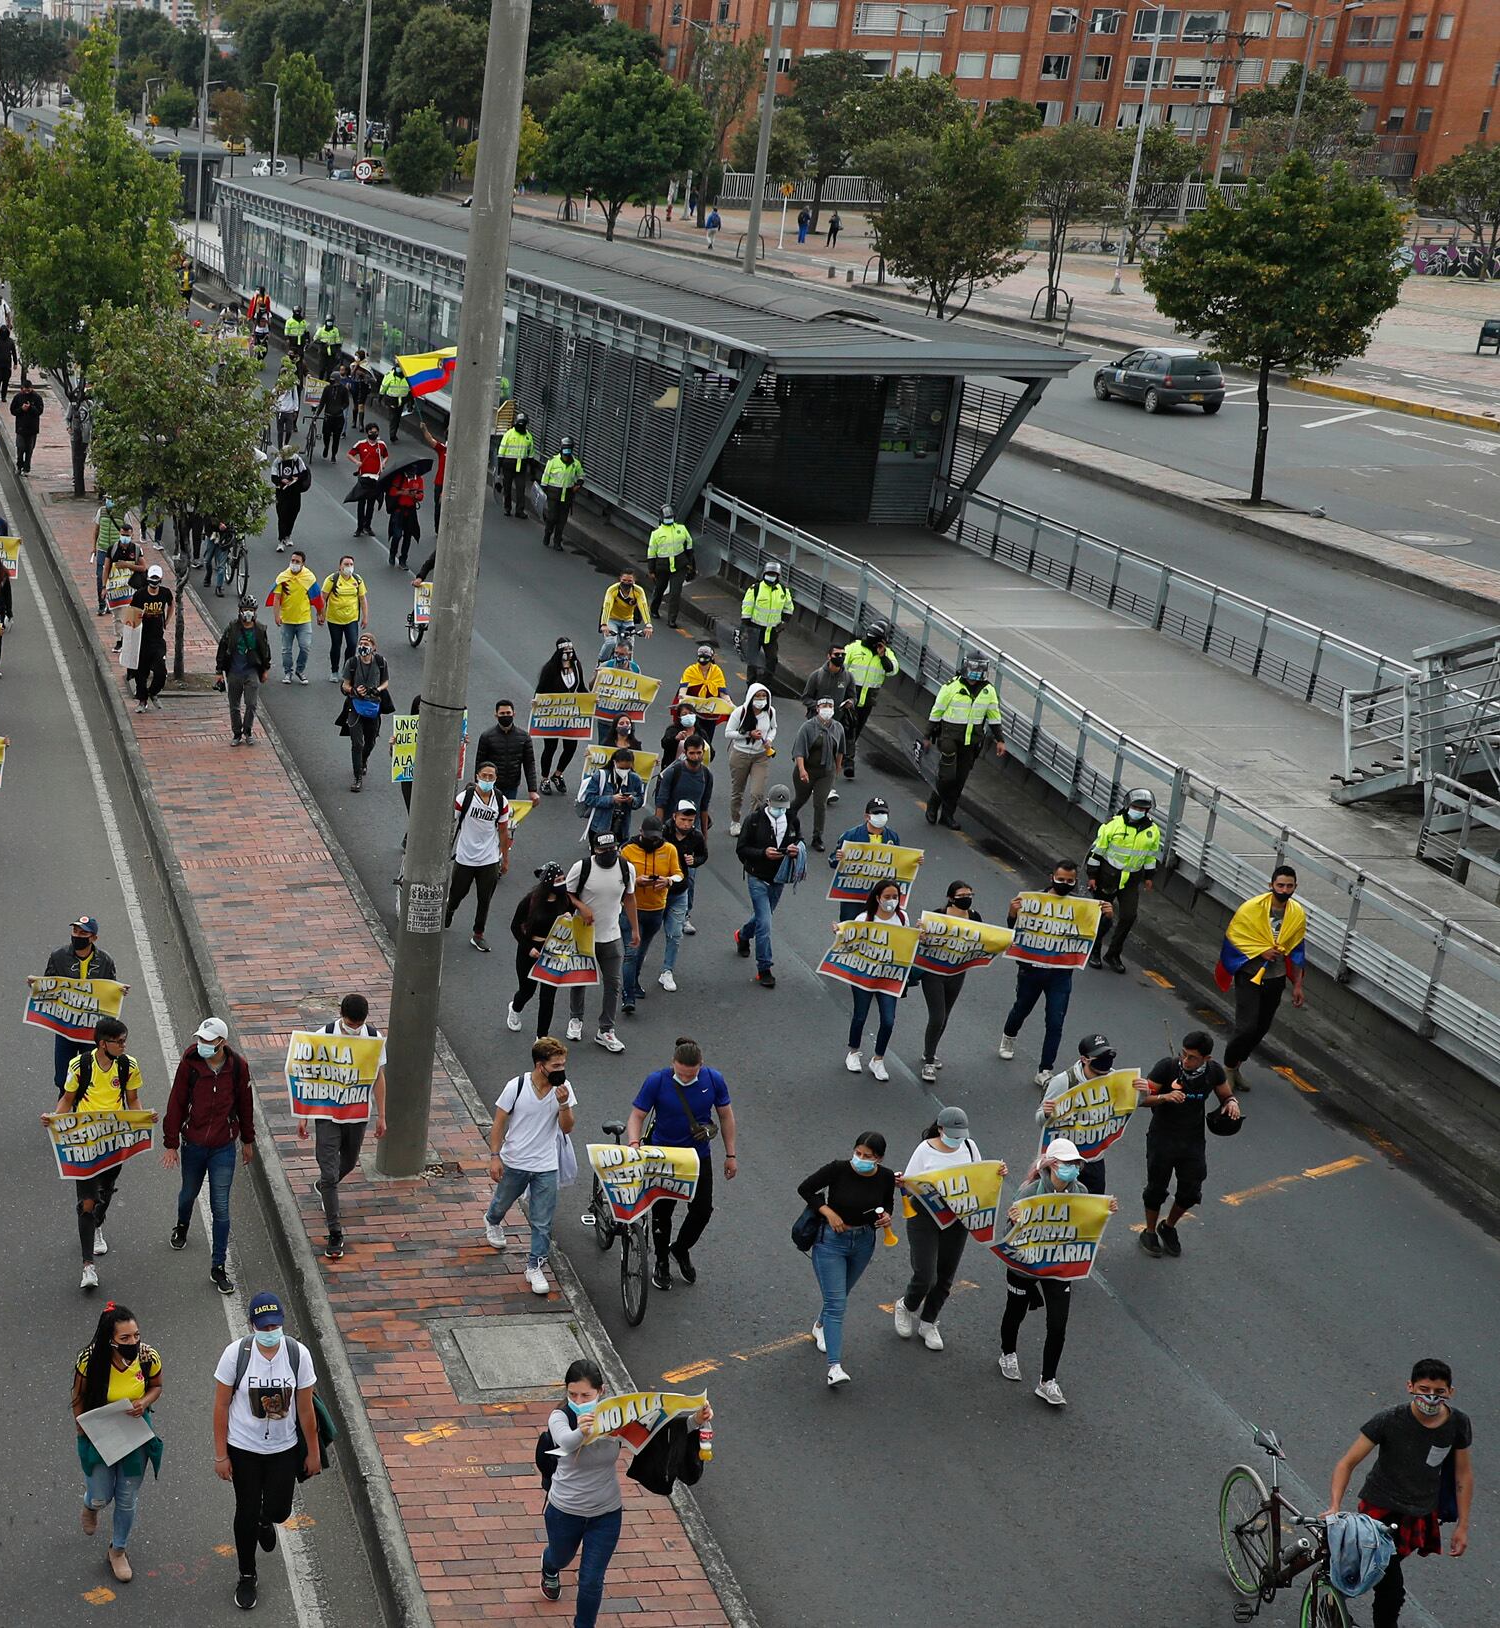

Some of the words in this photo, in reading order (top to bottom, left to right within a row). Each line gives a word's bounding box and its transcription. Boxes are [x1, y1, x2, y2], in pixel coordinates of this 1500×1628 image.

[358, 166, 370, 176] 50
[396, 719, 410, 730] UN
[396, 733, 413, 745] QUE
[393, 756, 400, 767] A
[401, 755, 413, 766] LA
[592, 753, 607, 764] NO
[469, 807, 496, 821] INSIDE
[846, 849, 862, 861] NO
[863, 850, 873, 862] A
[875, 851, 892, 864] LA
[840, 864, 897, 879] REFORMA
[1020, 898, 1039, 913] NO
[1042, 902, 1053, 916] A
[1057, 905, 1074, 920] LA
[553, 925, 570, 940] NO
[842, 928, 856, 943] NO
[858, 926, 869, 940] A
[871, 928, 889, 946] LA
[927, 920, 946, 935] NO
[950, 924, 961, 937] A
[964, 928, 981, 943] LA
[1018, 916, 1080, 937] REFORMA
[833, 942, 894, 963] REFORMA
[922, 935, 985, 953] REFORMA
[1014, 931, 1090, 955] TRIBUTARIA
[918, 946, 993, 965] TRIBUTARIA
[830, 952, 904, 981] TRIBUTARIA
[38, 979, 55, 993] NO
[59, 980, 71, 989] A
[74, 980, 93, 993] LA
[35, 989, 100, 1012] REFORMA
[33, 1000, 98, 1028] TRIBUTAR
[294, 1042, 314, 1061] NO
[317, 1045, 329, 1061] A
[331, 1046, 353, 1065] LA
[292, 1063, 359, 1085] REFORMA
[294, 1081, 368, 1105] TRIBUTARIA
[1056, 1098, 1072, 1117] NO
[1074, 1092, 1087, 1108] A
[1089, 1086, 1110, 1104] LA
[56, 1115, 77, 1132] NO
[80, 1113, 93, 1123] A
[95, 1112, 117, 1122] LA
[59, 1117, 131, 1145] REFORMA
[62, 1129, 151, 1163] TRIBUTARIA
[597, 1148, 623, 1168] NO
[627, 1148, 641, 1164] A
[950, 1175, 969, 1196] LA
[1031, 1205, 1044, 1222] A
[1046, 1203, 1070, 1222] LA
[1010, 1224, 1077, 1247] REFORMA
[1002, 1243, 1091, 1264] TRIBUTARIA
[254, 1304, 278, 1315] EAGLES
[248, 1376, 292, 1388] FUCK
[598, 1407, 622, 1433] NO
[626, 1402, 638, 1424] A
[642, 1394, 663, 1416] LA
